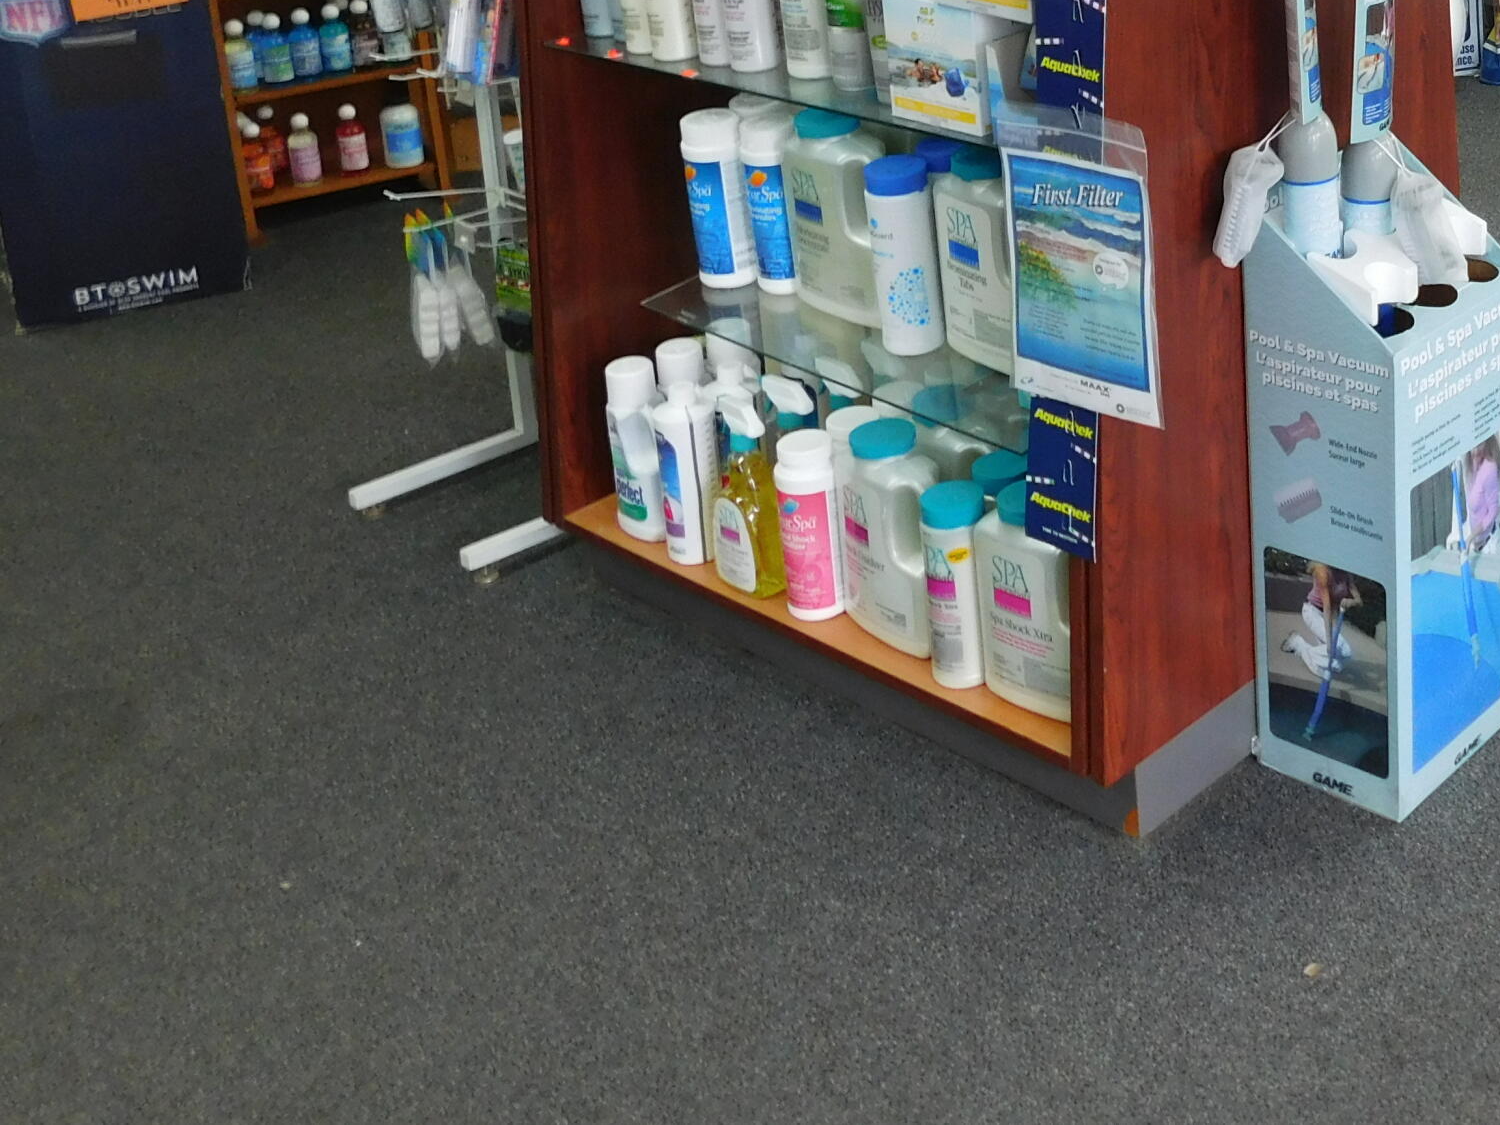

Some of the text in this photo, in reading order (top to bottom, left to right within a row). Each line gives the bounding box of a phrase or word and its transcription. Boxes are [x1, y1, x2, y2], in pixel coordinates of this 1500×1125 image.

[4, 0, 65, 34] NFL
[1040, 56, 1100, 83] AquaChek
[1032, 183, 1125, 208] First Filter
[946, 207, 977, 244] SPA
[1249, 330, 1390, 379] Pool & Spa Vacuum
[1400, 339, 1434, 377] Pool
[1435, 336, 1445, 356] &
[1447, 323, 1473, 349] Spa
[1080, 379, 1111, 393] MAAX
[1256, 350, 1382, 396] L'aspirateur pour
[1407, 341, 1489, 399] L'aspirateur
[1262, 370, 1379, 413] piscines et spas
[1415, 372, 1473, 424] piscines
[1473, 362, 1489, 381] et
[1034, 407, 1094, 440] AquaChek
[1030, 491, 1092, 523] AquaChek
[991, 555, 1029, 593] SPA
[990, 611, 1004, 627] Spa
[1004, 617, 1031, 637] Shock
[1033, 627, 1054, 643] Xtra
[1312, 771, 1354, 796] GAME
